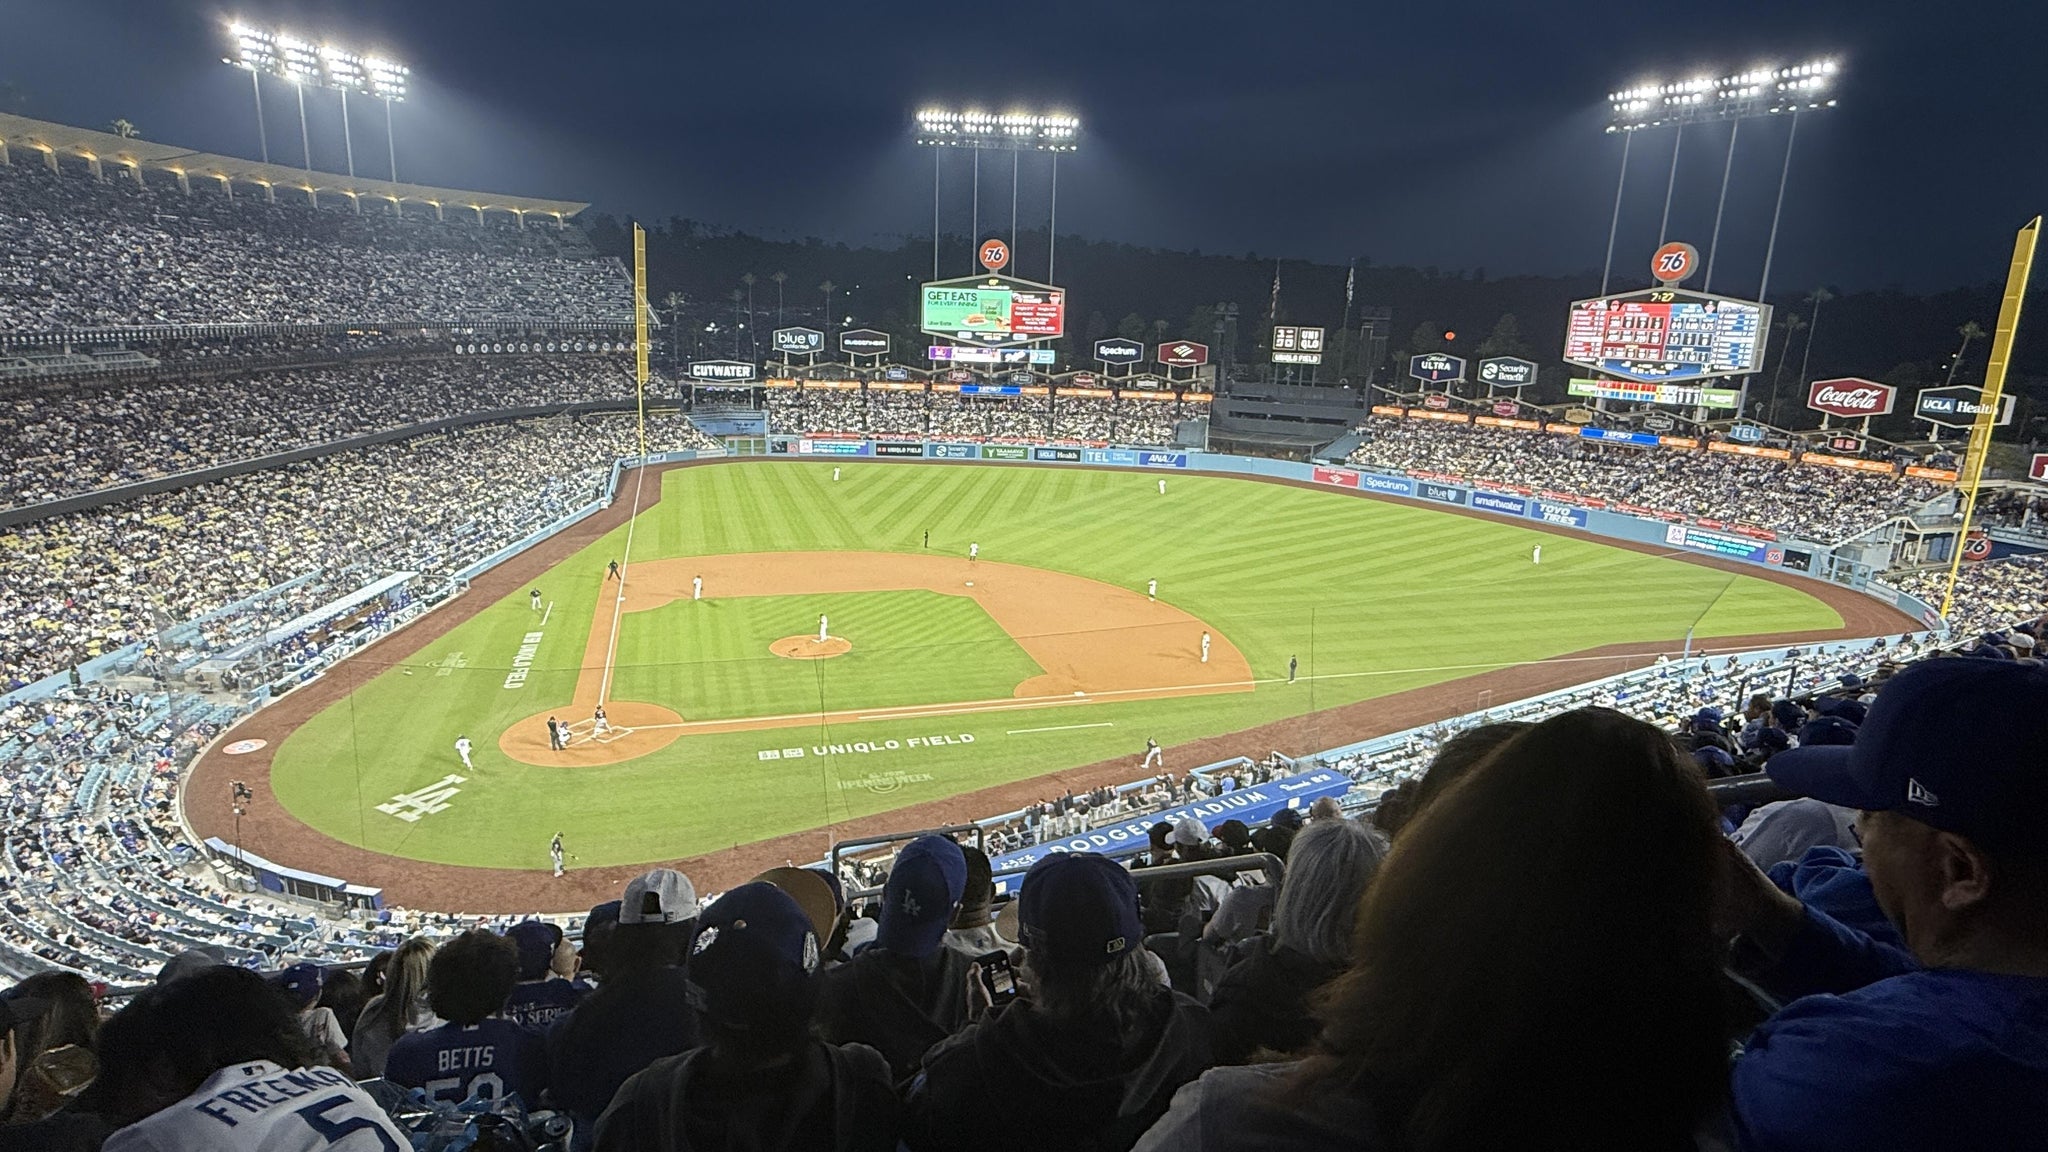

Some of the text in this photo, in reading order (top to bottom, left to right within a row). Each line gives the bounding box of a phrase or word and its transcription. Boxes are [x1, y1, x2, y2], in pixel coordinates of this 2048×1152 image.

[985, 247, 1004, 262] 76
[1659, 251, 1686, 272] 76
[928, 292, 978, 302] GET EATS
[1650, 292, 1674, 302] 7:27
[1302, 330, 1320, 340] UNI
[1300, 340, 1320, 349] QLO
[1100, 346, 1136, 356] Spectrum
[692, 366, 751, 378] CUTWATER
[1421, 362, 1450, 370] ULTRA
[1499, 364, 1529, 374] Security
[1498, 372, 1524, 381] Benefit
[1814, 386, 1883, 410] Coca-Cola
[1923, 400, 1951, 410] UCLA
[1734, 426, 1757, 438] TEL
[1039, 450, 1054, 458] UCLA
[1087, 452, 1109, 462] TEL
[1148, 454, 1168, 462] ANA
[1366, 478, 1404, 490] Spectrum
[1428, 486, 1446, 498] blue
[1474, 497, 1522, 511] smartwater
[1540, 504, 1570, 516] TOYO
[1543, 512, 1580, 526] TIRES
[1963, 539, 1986, 554] 76
[1770, 552, 1780, 560] 76
[812, 740, 900, 756] UNIQLO
[906, 733, 976, 748] FIELD
[1164, 792, 1270, 825] STADIUM
[438, 1046, 494, 1072] BETTS
[195, 1070, 359, 1127] FREEMA
[425, 1072, 504, 1114] 50
[294, 1094, 400, 1152] 5
